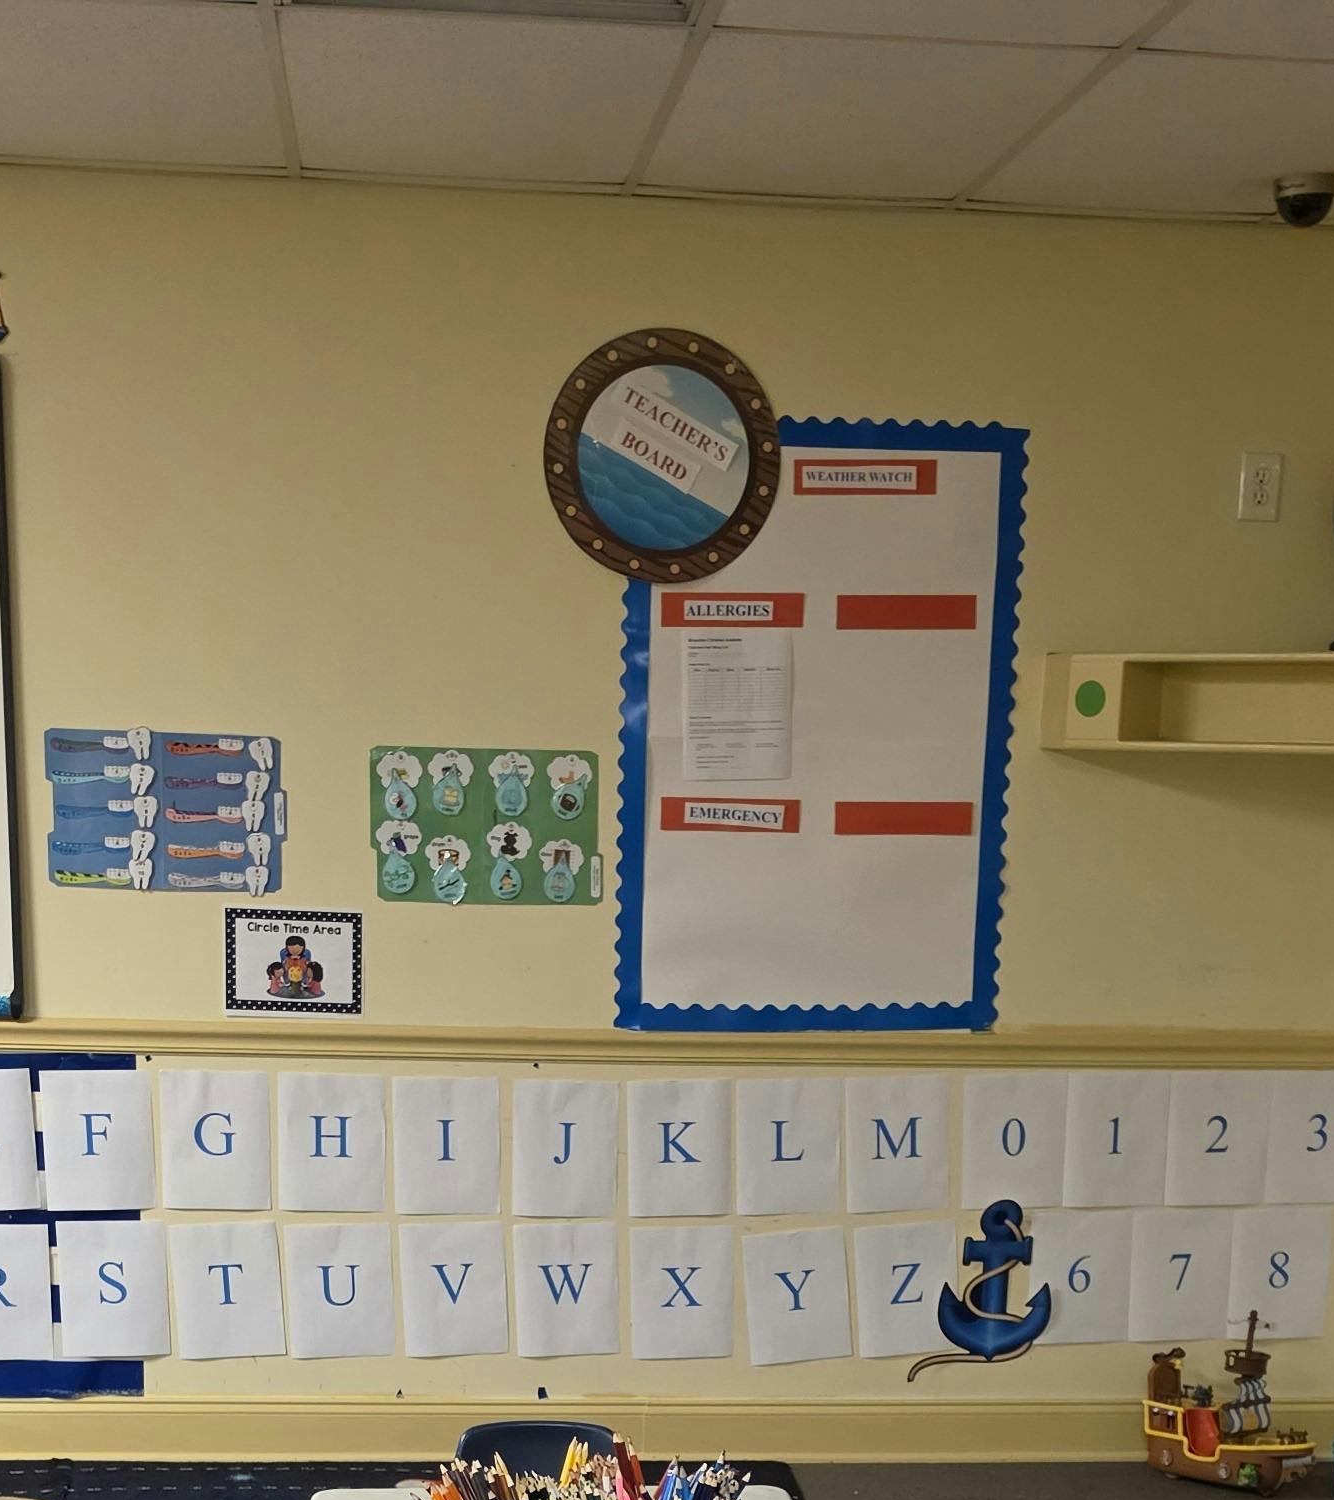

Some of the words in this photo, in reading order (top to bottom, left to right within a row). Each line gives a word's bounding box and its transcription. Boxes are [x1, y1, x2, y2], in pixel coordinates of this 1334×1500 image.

[623, 386, 729, 462] TEACHER'S
[619, 432, 688, 481] BOARD
[805, 470, 866, 484] WEATHER
[868, 470, 914, 484] WATCH
[685, 603, 772, 619] ALLERGIES
[688, 805, 783, 825] EMERGENCY
[247, 921, 280, 933] Circle
[283, 923, 310, 935] Time
[313, 924, 342, 936] Area
[79, 1113, 113, 1156] F
[193, 1112, 235, 1157] G
[309, 1115, 353, 1158] H
[435, 1119, 456, 1162] I
[553, 1122, 577, 1165] J
[658, 1121, 702, 1164] K
[770, 1120, 805, 1162] L
[871, 1116, 923, 1160] M
[1108, 1117, 1122, 1154] 1
[1205, 1116, 1228, 1154] 2
[1306, 1114, 1329, 1153] 3
[98, 1261, 128, 1305] S
[208, 1263, 243, 1305] T
[317, 1264, 360, 1306] U
[431, 1262, 473, 1305] V
[539, 1263, 593, 1305] W
[661, 1266, 702, 1308] X
[774, 1269, 816, 1311] Y
[890, 1262, 924, 1304] Z
[1067, 1255, 1091, 1293] 6
[1169, 1253, 1192, 1291] 7
[1268, 1251, 1290, 1289] 8
